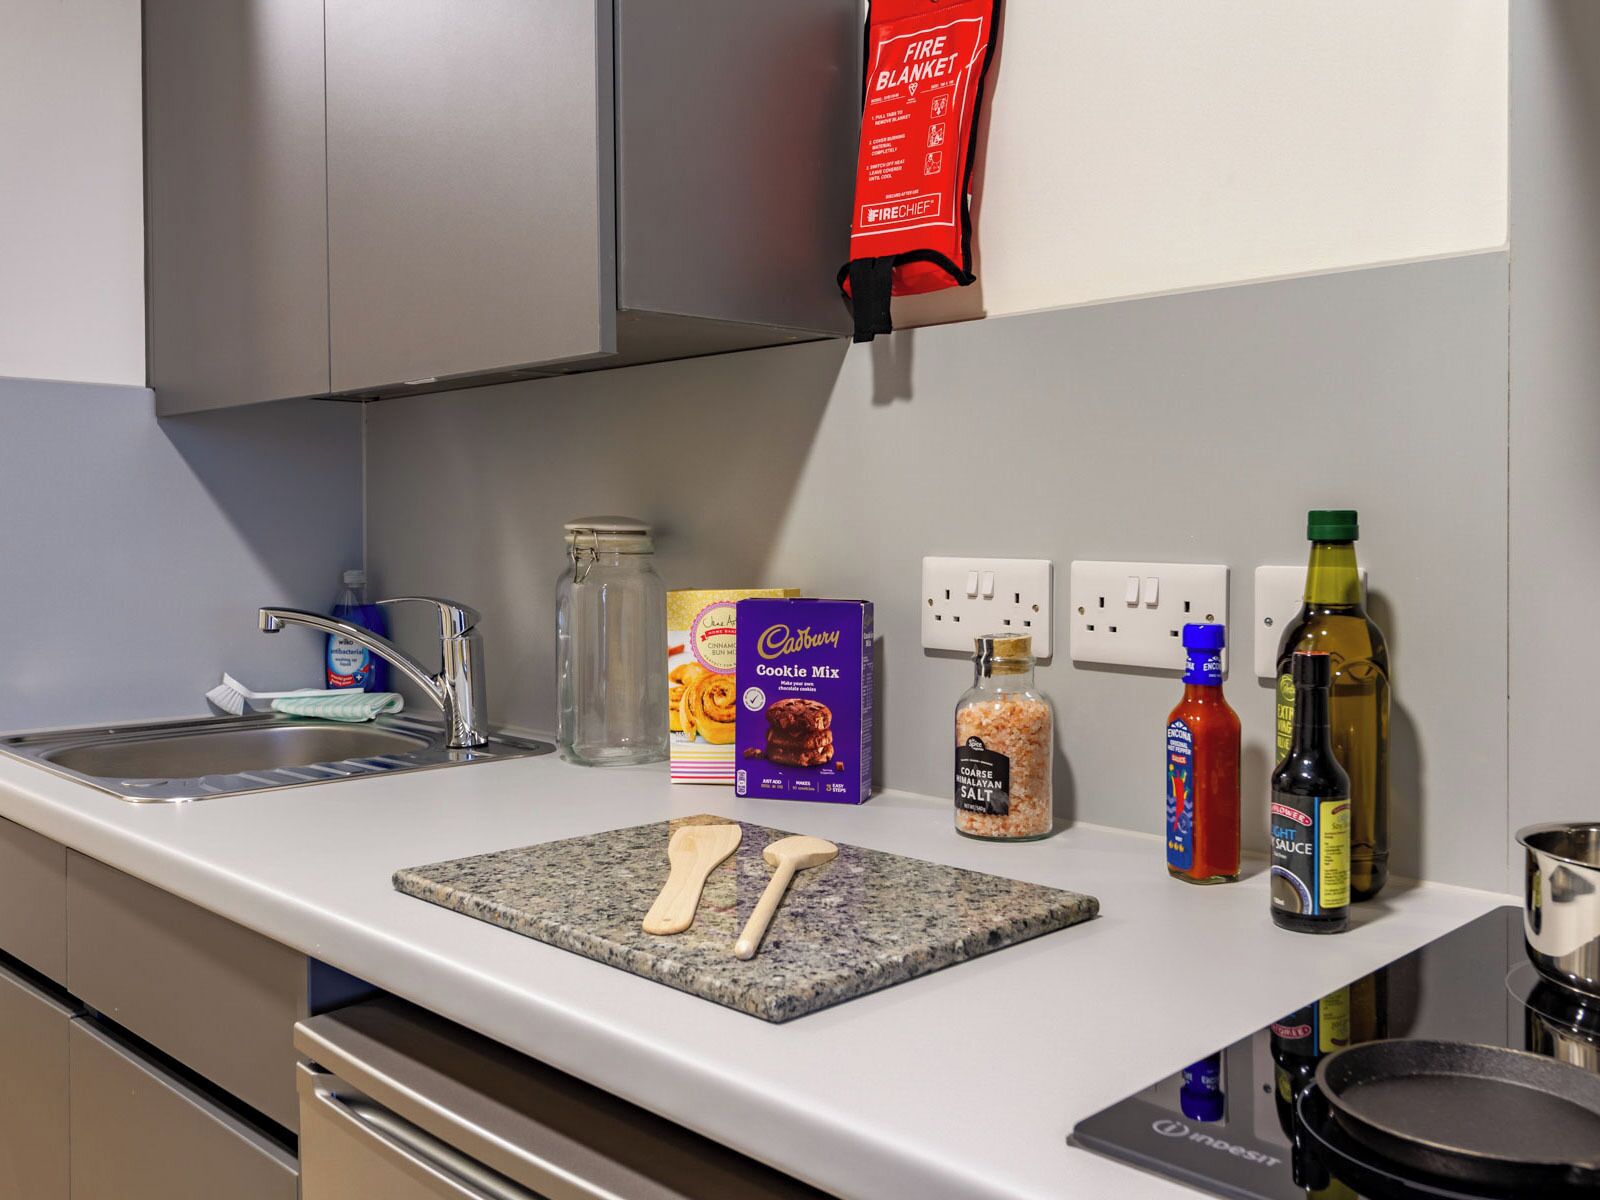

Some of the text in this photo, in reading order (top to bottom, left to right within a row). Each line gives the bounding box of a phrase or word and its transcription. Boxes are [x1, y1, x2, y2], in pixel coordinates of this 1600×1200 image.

[903, 36, 947, 63] FIRE
[876, 52, 958, 91] BLANKET
[892, 114, 911, 123] BLANKET
[868, 200, 932, 222] FIRECHIEF
[757, 623, 840, 659] Cadbury
[756, 664, 840, 678] Cookie Mix
[1278, 704, 1294, 720] EXTR
[1168, 729, 1192, 743] ENCONA
[960, 766, 993, 779] COARSE
[825, 784, 832, 792] 3
[960, 785, 993, 802] SALT
[1275, 838, 1312, 855] SAUCE
